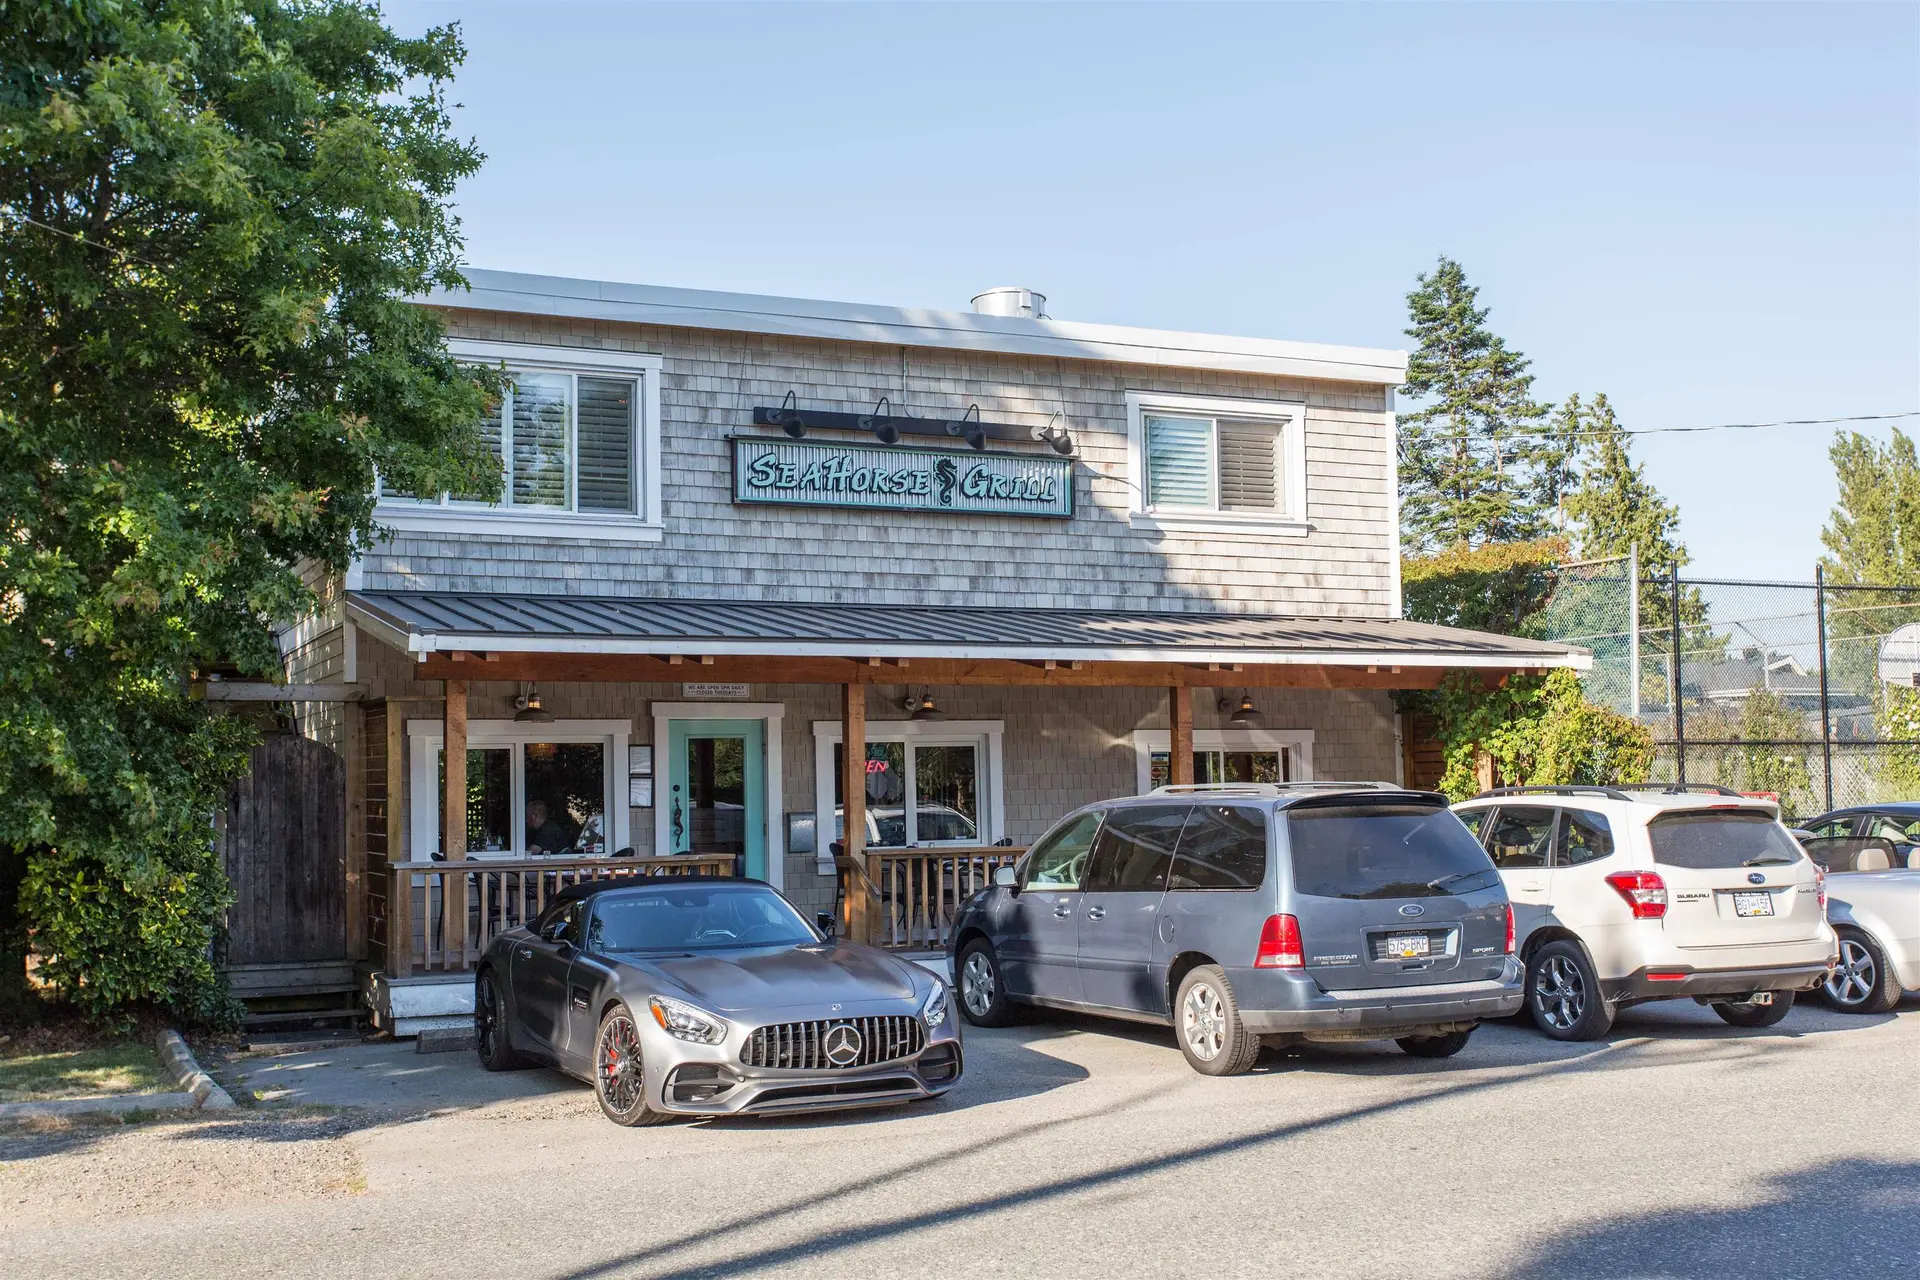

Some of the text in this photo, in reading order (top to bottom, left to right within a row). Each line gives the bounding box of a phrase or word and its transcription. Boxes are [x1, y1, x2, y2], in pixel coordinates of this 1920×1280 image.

[963, 463, 1057, 502] GRILL
[865, 760, 887, 773] EN
[1389, 938, 1406, 951] 575
